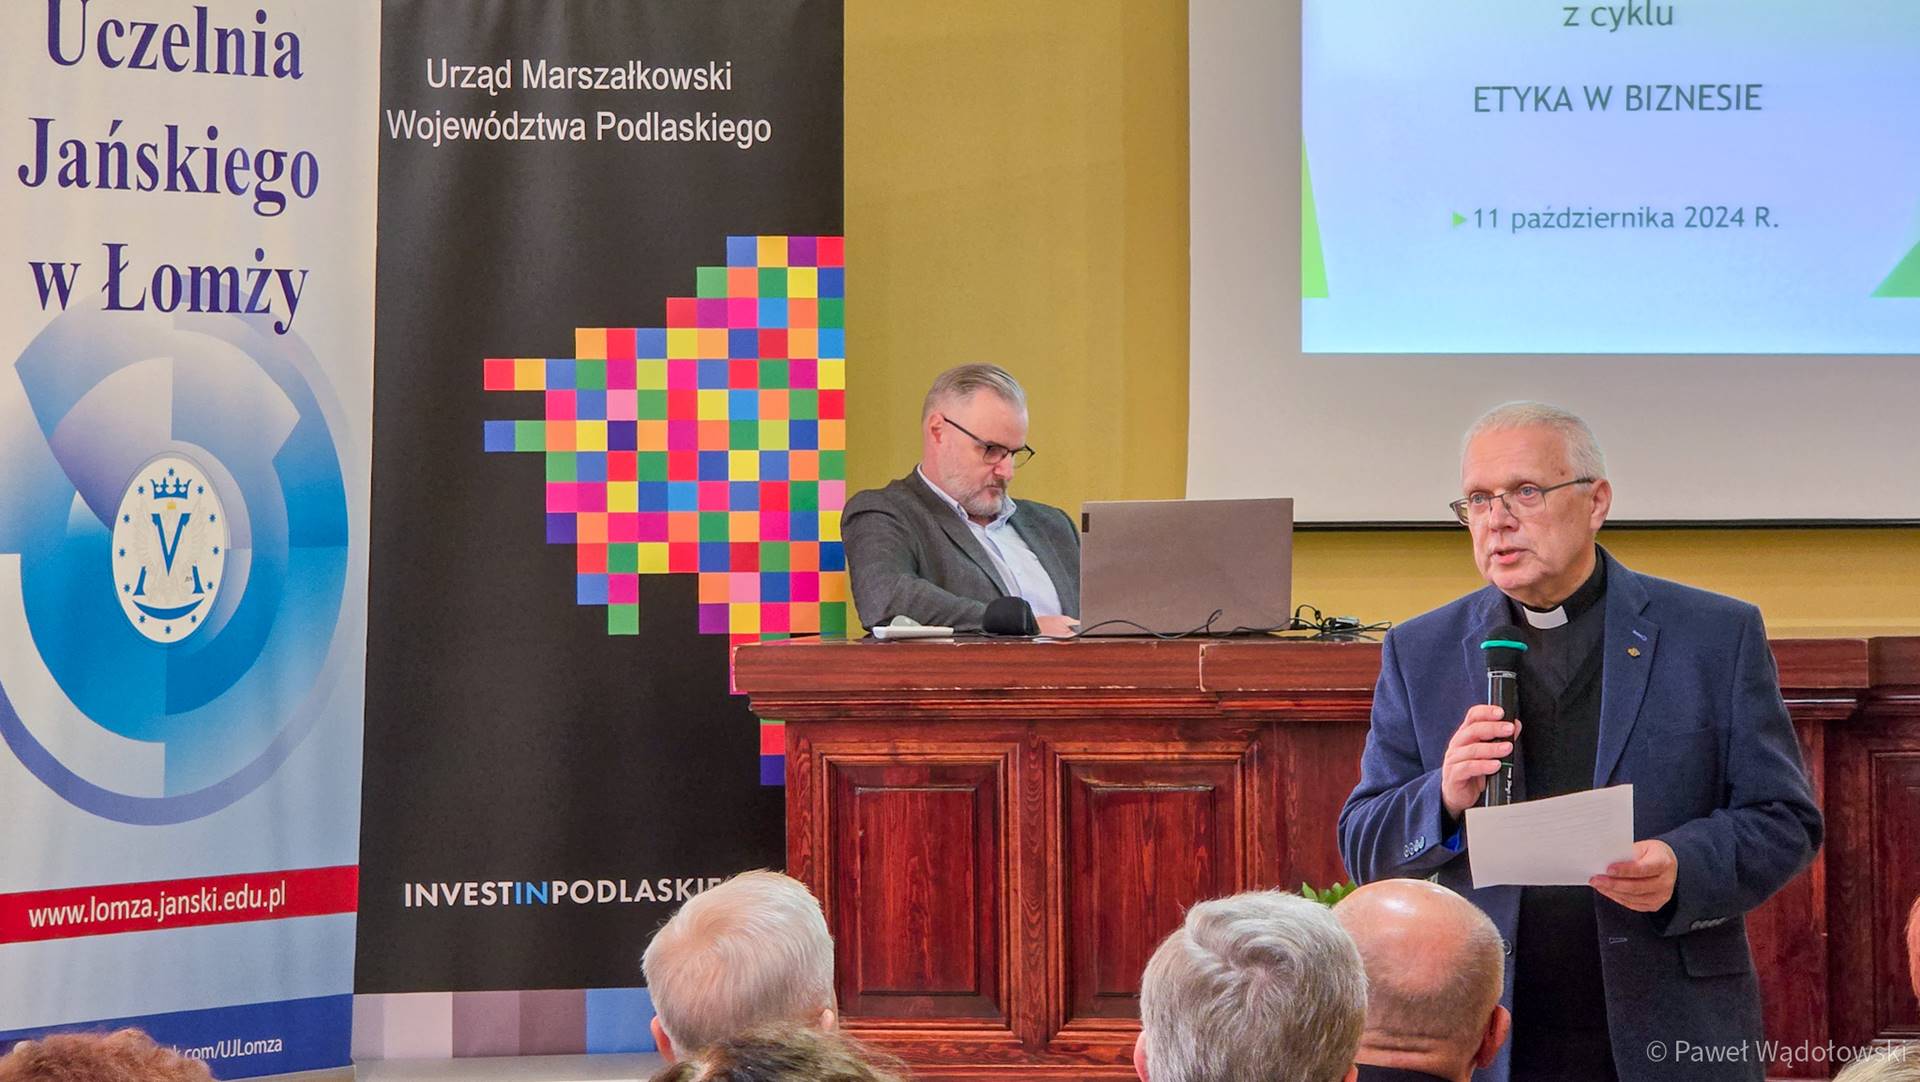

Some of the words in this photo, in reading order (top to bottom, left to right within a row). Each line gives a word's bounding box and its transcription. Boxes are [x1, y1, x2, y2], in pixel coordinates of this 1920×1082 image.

[1563, 6, 1580, 27] z
[1590, 0, 1674, 33] cyklu
[47, 0, 304, 80] Uczelnia
[426, 58, 511, 96] Urząd
[522, 58, 732, 91] Marszałkowski
[1474, 86, 1573, 112] ETYKA
[1583, 85, 1613, 111] W
[1625, 84, 1763, 111] BIZNESIE
[386, 109, 586, 147] Województwa
[596, 111, 772, 149] Podlaskiego
[17, 117, 320, 217] Jańskiego
[1473, 209, 1498, 229] 11
[1511, 205, 1675, 234] października
[1684, 206, 1745, 228] 2024
[1755, 207, 1780, 228] R.
[28, 261, 82, 312] w
[101, 242, 309, 335] Łomży
[28, 879, 287, 928] www.lomza.janski.edu.pl
